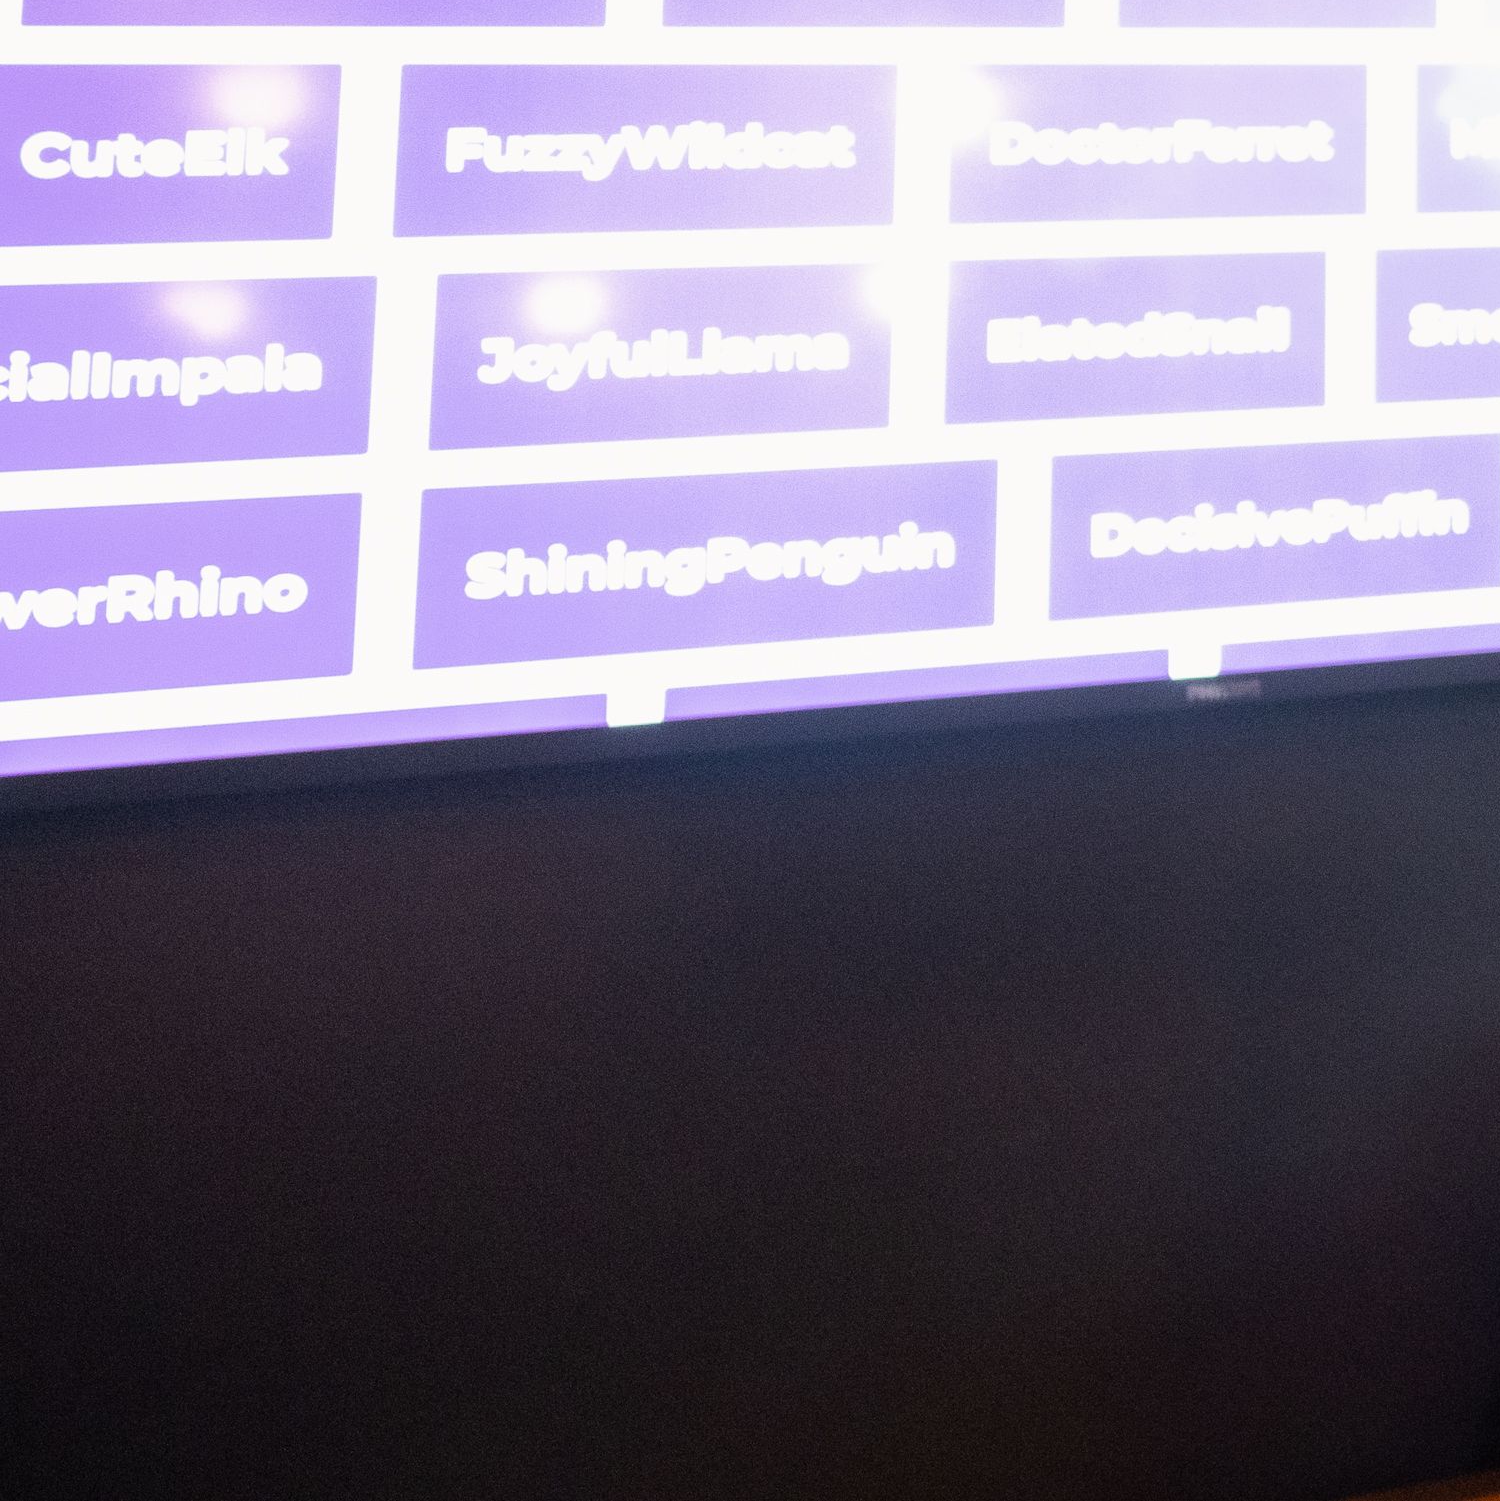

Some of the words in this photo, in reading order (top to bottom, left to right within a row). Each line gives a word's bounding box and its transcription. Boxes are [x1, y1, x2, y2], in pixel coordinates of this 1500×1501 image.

[20, 125, 290, 179] CuteElk
[446, 120, 857, 181] FuzzyWildcat
[477, 326, 850, 391] JoyfulLlama
[1090, 489, 1470, 558] DecisivePuffin
[465, 521, 956, 600] ShiningPenguin
